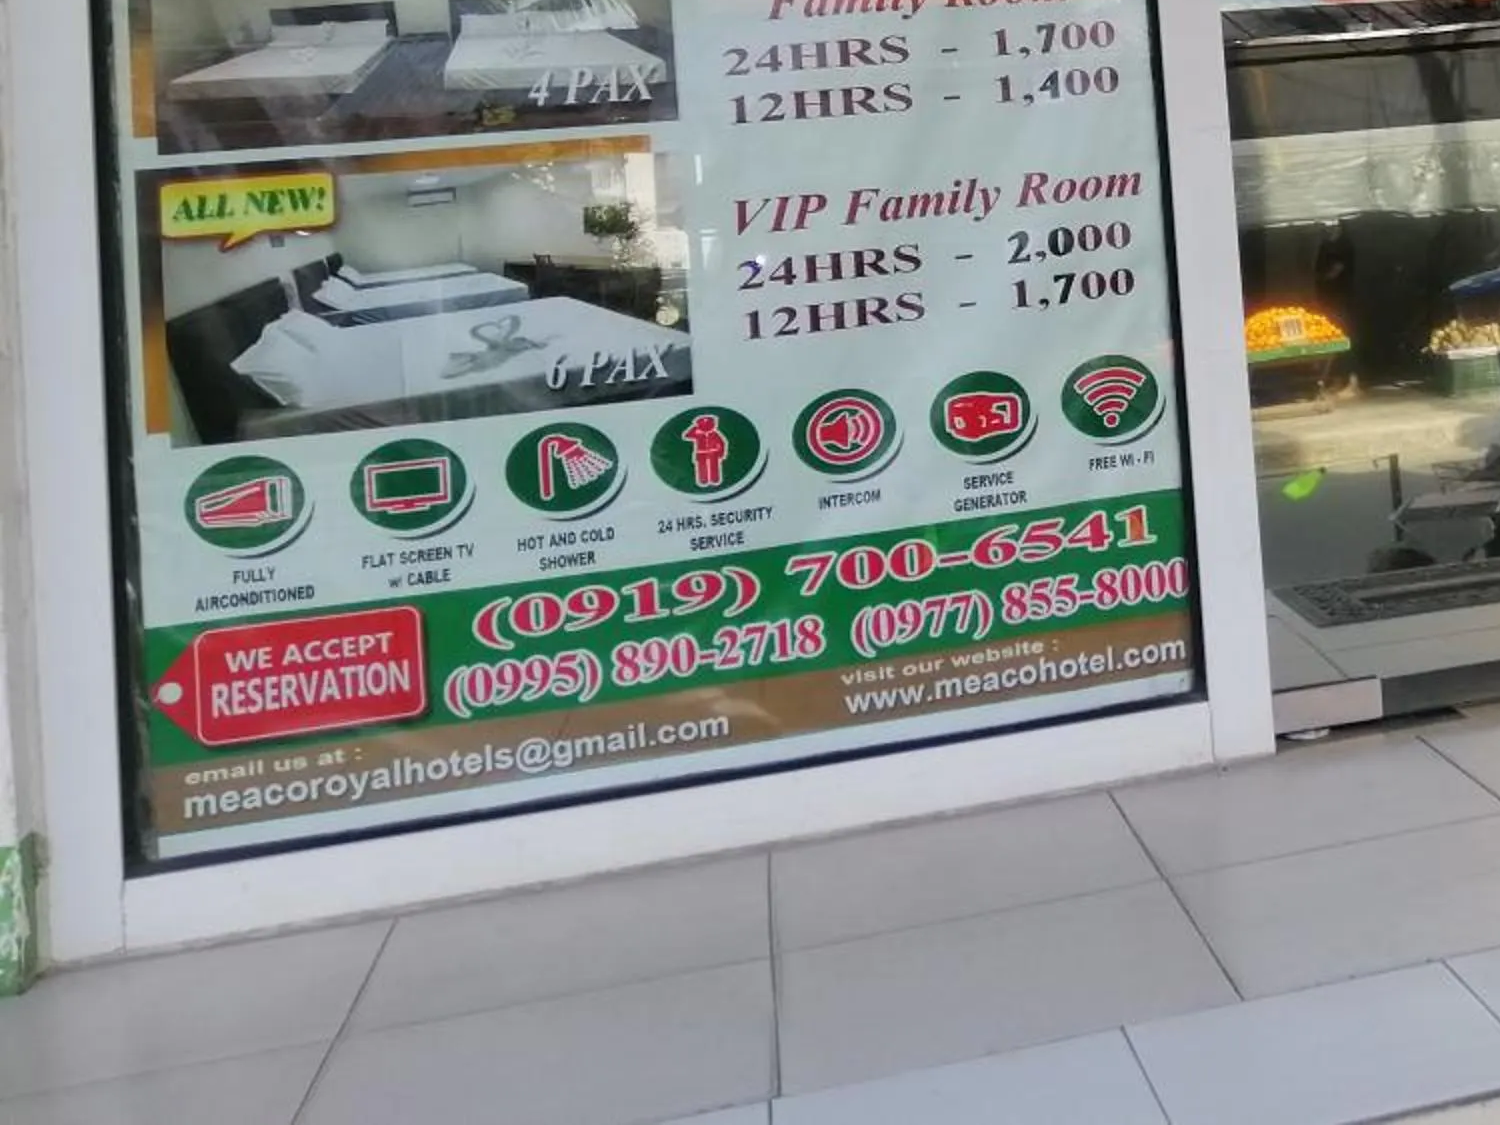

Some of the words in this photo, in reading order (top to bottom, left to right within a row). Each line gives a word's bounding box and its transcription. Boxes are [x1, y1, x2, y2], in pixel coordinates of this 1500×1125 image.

[723, 35, 910, 76] 24HRS
[993, 20, 1116, 58] 1,700
[527, 70, 551, 106] 4
[564, 63, 660, 105] PAX
[730, 83, 913, 126] 12HRS
[994, 66, 1120, 106] 1,400
[171, 194, 236, 222] ALL
[244, 186, 327, 217] NEW!
[734, 194, 827, 236] VIP
[842, 178, 1001, 226] Family
[1016, 170, 1143, 208] Room
[737, 243, 923, 291] 24HRS
[1007, 222, 1132, 264] 2,000
[743, 291, 926, 341] 12HRS
[1010, 268, 1135, 311] 1,700
[545, 356, 567, 390] 6
[580, 344, 675, 387] PAX
[963, 472, 1014, 491] SERVICE
[1089, 455, 1120, 471] FREE
[657, 520, 673, 534] 24
[675, 515, 707, 533] HRS.
[710, 506, 774, 527] SECURITY
[818, 489, 882, 509] INTERCOM
[953, 490, 1028, 513] GENERATOR
[362, 553, 395, 570] FLAT
[399, 547, 454, 565] SCREEN
[458, 542, 476, 558] TV
[517, 536, 545, 552] HOT
[549, 531, 577, 547] AND
[579, 527, 615, 543] COLD
[689, 531, 745, 551] SERVICE
[233, 567, 276, 585] FULLY
[407, 568, 452, 586] CABLE
[472, 567, 761, 650] (0919)
[784, 506, 1158, 597] 700-6541
[539, 552, 596, 571] SHOWER
[195, 585, 315, 613] AIRCONDITIONED
[851, 590, 993, 656] (0977)
[1001, 557, 1191, 624] 855-8000
[224, 649, 273, 673] WE
[282, 631, 394, 664] ACCEPT
[444, 648, 602, 719] (0995)
[611, 616, 826, 688] 890-2718
[842, 667, 896, 686] visit
[902, 659, 942, 679] our
[953, 639, 1044, 671] website
[211, 660, 411, 719] RESERVATION
[845, 637, 1186, 715] www.meacohotel.com
[183, 758, 265, 786] email
[274, 755, 308, 774] us
[316, 747, 346, 767] at
[183, 715, 729, 819] meacoroyalhotels@gmail.com
